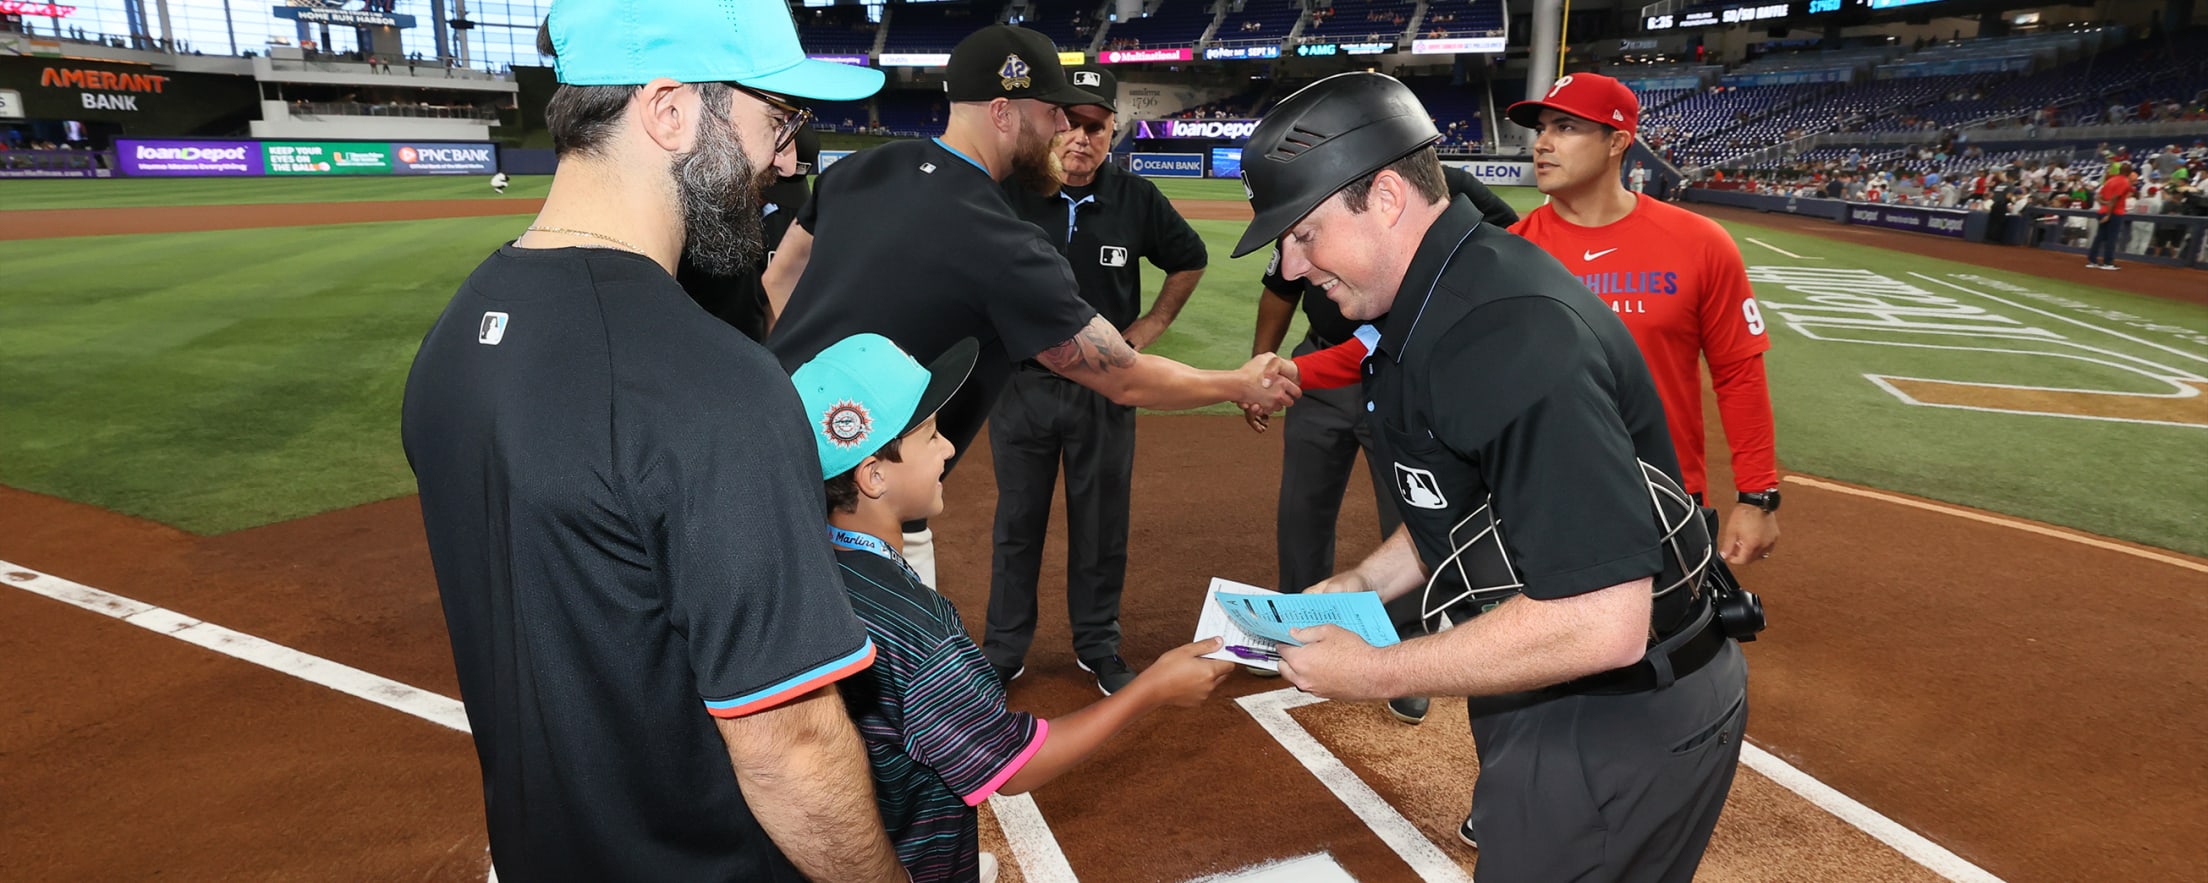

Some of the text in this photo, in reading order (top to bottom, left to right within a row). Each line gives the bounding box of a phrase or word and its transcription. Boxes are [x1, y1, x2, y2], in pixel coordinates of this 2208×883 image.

[298, 11, 395, 25] HOME RUN HARBOR
[1121, 50, 1180, 61] Multinational
[1248, 47, 1266, 57] SEPT
[1309, 44, 1336, 56] AMG
[1003, 61, 1026, 78] 42
[41, 67, 165, 94] AMERANT
[1554, 76, 1573, 98] P
[81, 92, 138, 111] BANK
[137, 145, 246, 162] loanDepot
[269, 146, 322, 155] KEEP YOUR
[417, 149, 489, 161] PNC BANK
[271, 163, 291, 171] THE
[1144, 160, 1200, 170] OCEAN BANK
[1475, 165, 1521, 177] LEON
[836, 532, 875, 549] Marlins
